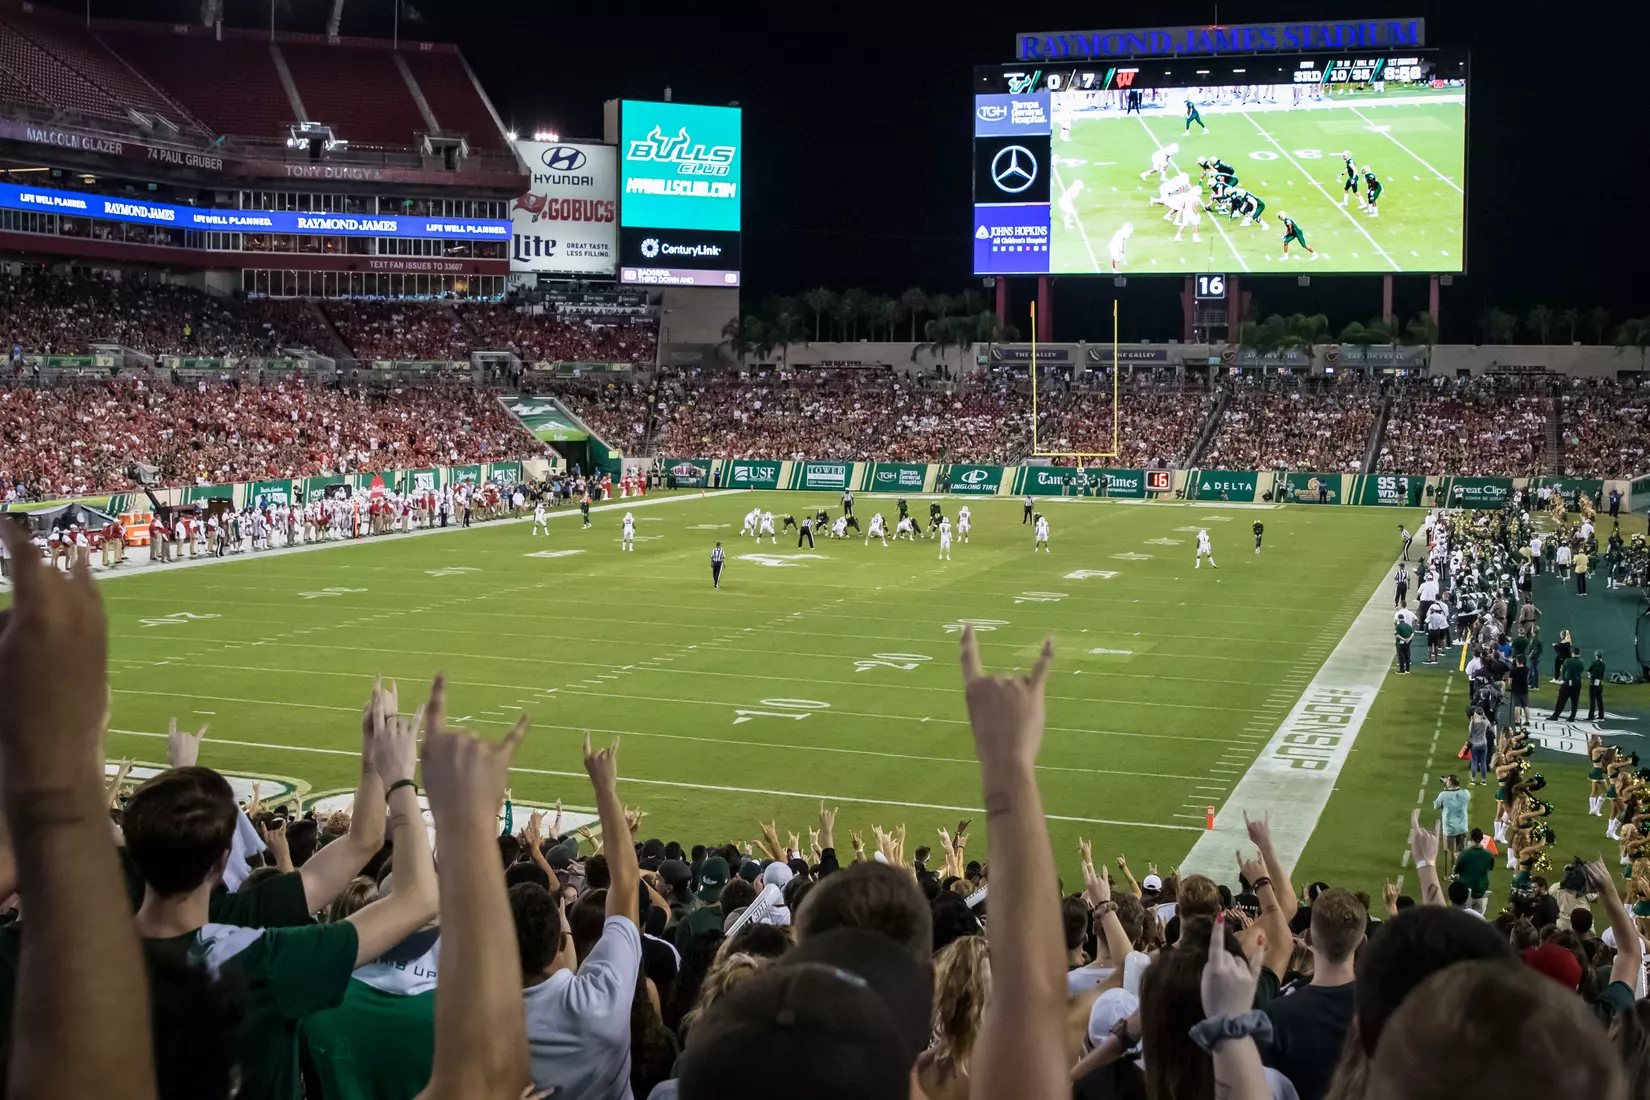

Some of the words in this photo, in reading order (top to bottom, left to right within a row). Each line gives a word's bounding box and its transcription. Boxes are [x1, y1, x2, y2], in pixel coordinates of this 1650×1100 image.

[1021, 30, 1171, 59] RAYMOND
[1175, 27, 1276, 55] JAMES
[1282, 21, 1418, 49] STADIUM
[1047, 74, 1060, 89] 0
[1082, 73, 1095, 88] 7
[1293, 70, 1322, 82] 3RD
[1330, 70, 1347, 81] 10
[980, 105, 1007, 117] TGH
[1011, 100, 1039, 110] Tampa
[1011, 108, 1044, 117] General
[26, 127, 80, 148] MALCOLM
[82, 137, 123, 155] GLAZER
[626, 125, 736, 164] BULLS
[147, 147, 158, 160] 74
[160, 150, 184, 165] PAUL
[185, 155, 223, 171] GRUBER
[284, 164, 321, 178] TONY
[324, 166, 372, 180] DUNGY
[678, 163, 730, 176] CLUB
[534, 174, 594, 186] HYUNDAI
[20, 192, 35, 203] LIFE
[36, 194, 53, 206] WELL
[104, 201, 148, 218] RAYMOND
[147, 207, 175, 221] JAMES
[541, 198, 615, 223] #GOBUCS
[194, 214, 206, 223] LIFE
[206, 215, 228, 225] WELL
[298, 217, 358, 230] RAYMOND
[358, 219, 398, 232] JAMES
[426, 223, 443, 233] LIFE
[443, 224, 466, 234] WELL
[990, 226, 1014, 238] JOHNS
[1014, 225, 1048, 236] HOPKINS
[566, 242, 588, 250] GREAT
[588, 242, 611, 250] TASTE.
[1026, 237, 1048, 245] Hospital
[512, 233, 557, 263] Lite
[566, 250, 583, 258] LESS
[662, 243, 720, 257] CenturyLink
[370, 260, 388, 270] TEXT
[390, 261, 404, 270] FAN
[405, 262, 432, 270] ISSUES
[434, 262, 443, 270] TO
[638, 276, 658, 284] THIRD
[659, 276, 680, 284] DOWN
[1199, 276, 1224, 294] 16
[502, 469, 516, 480] USF
[748, 466, 775, 479] USF
[810, 466, 844, 474] TOWER
[880, 472, 896, 480] TGH
[1038, 472, 1076, 485] Tama
[1104, 474, 1138, 488] Times
[1154, 473, 1168, 487] 16
[1214, 482, 1252, 491] DELTA
[1483, 484, 1508, 496] Clips
[854, 652, 933, 672] 20
[732, 698, 831, 724] 10
[413, 965, 437, 979] UP
